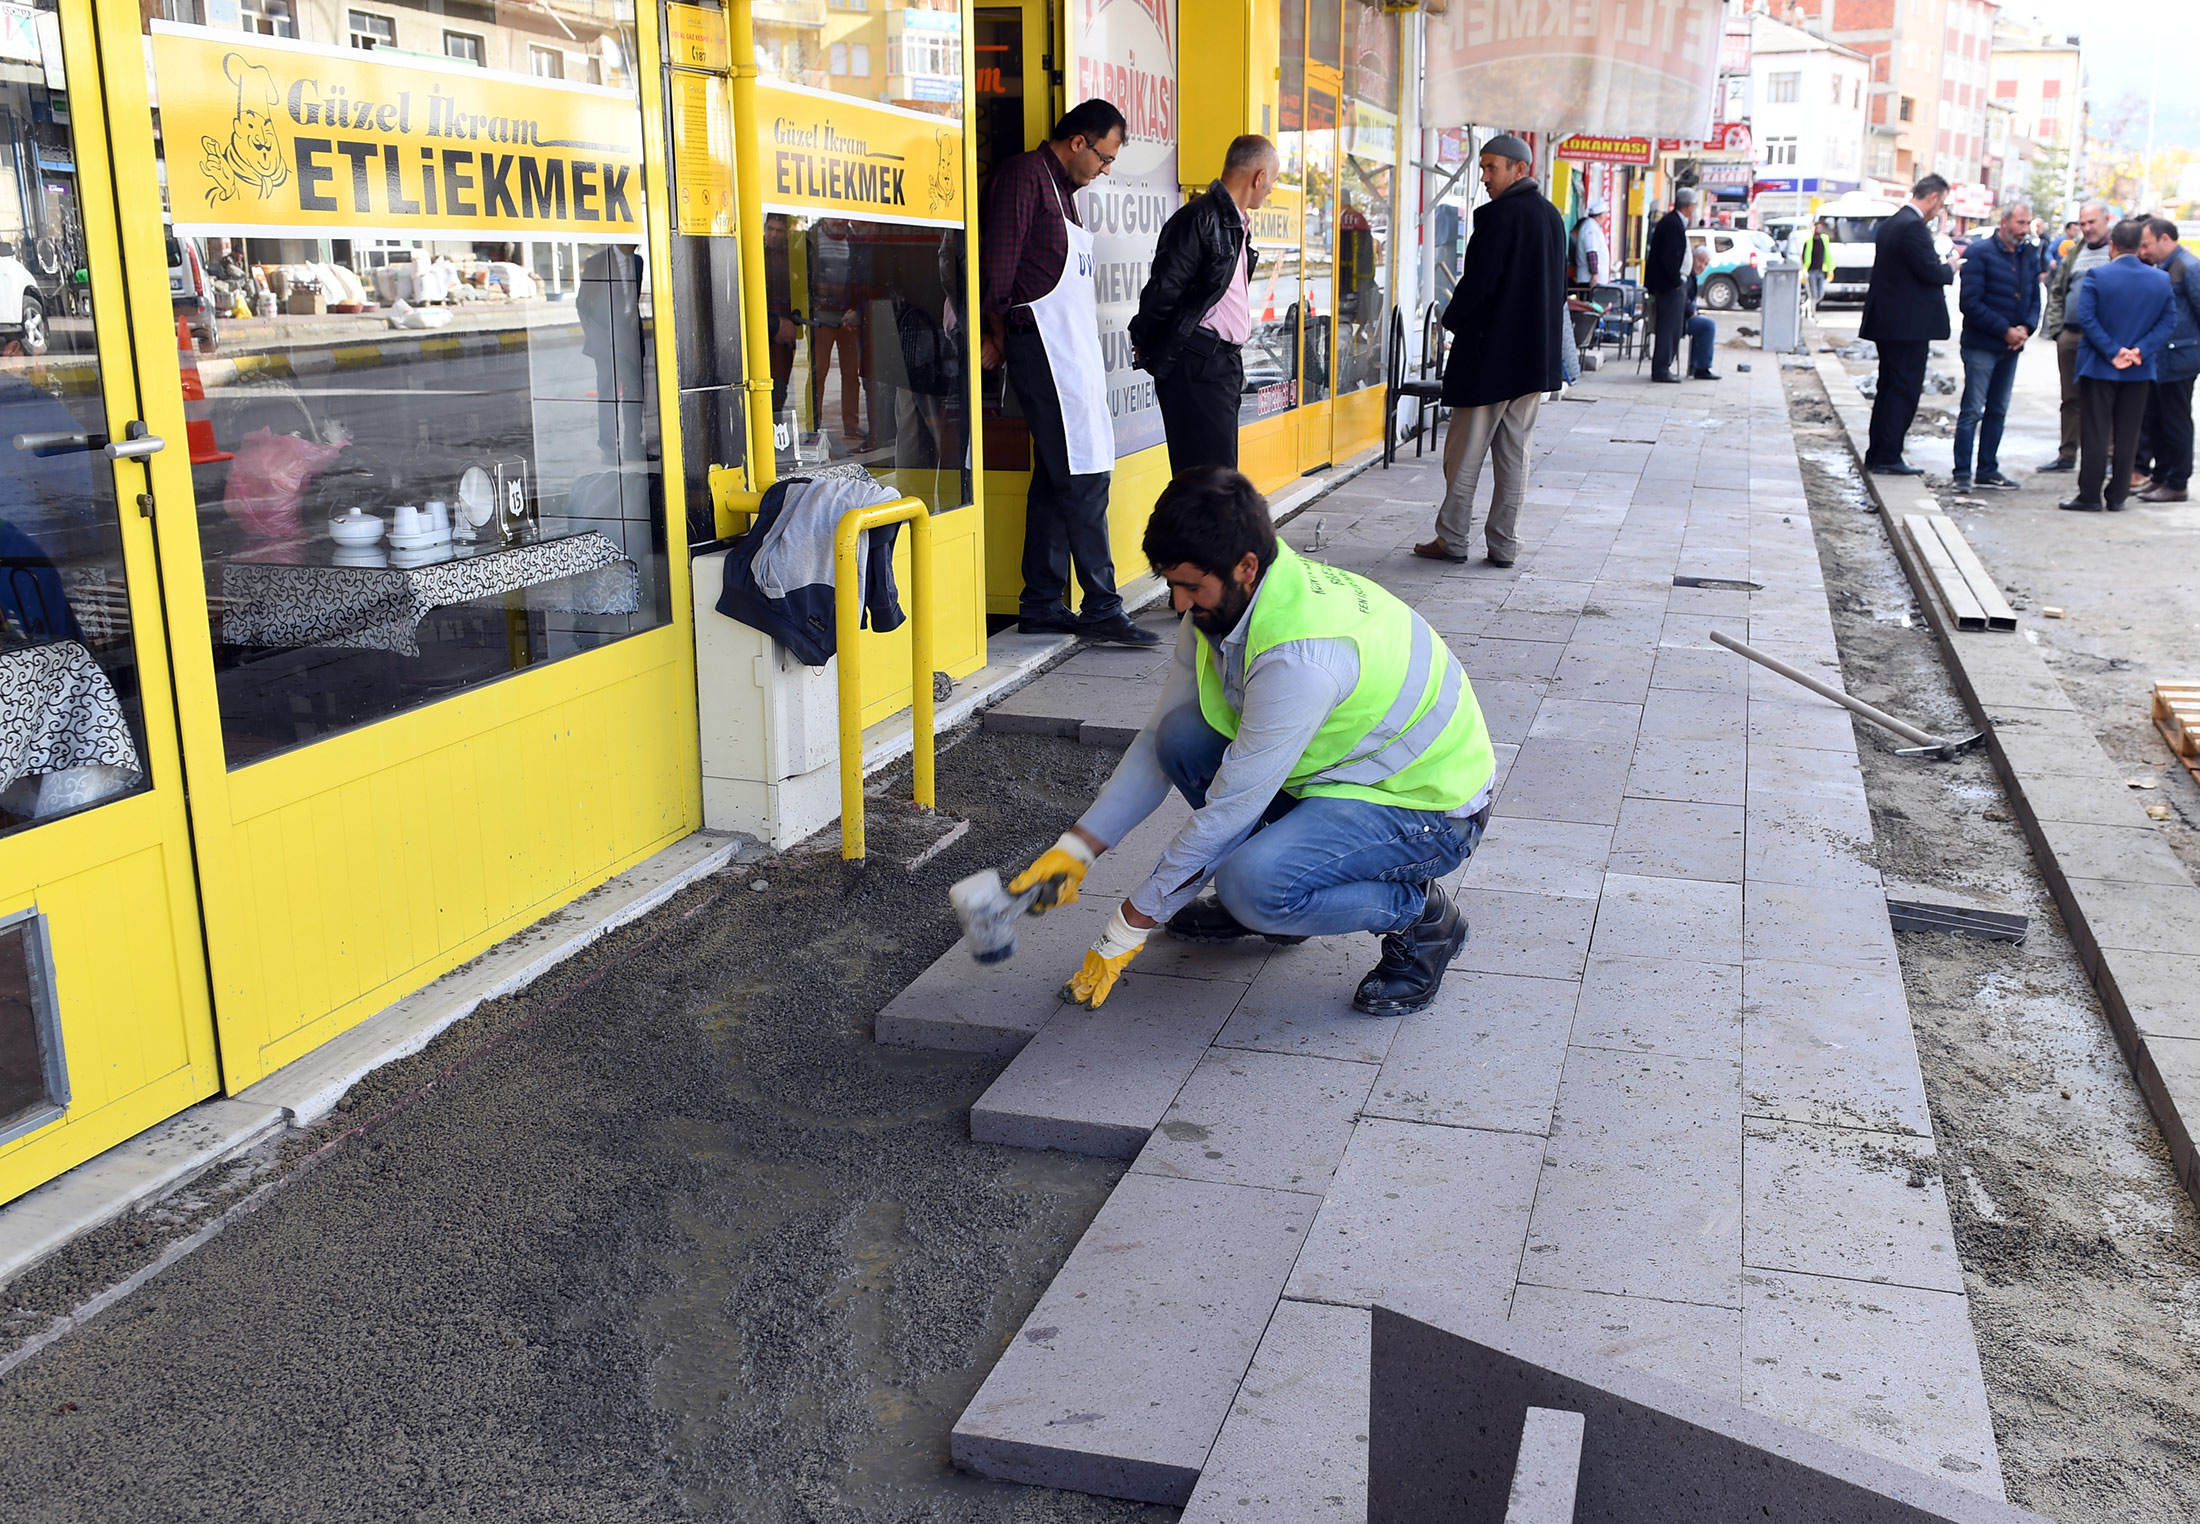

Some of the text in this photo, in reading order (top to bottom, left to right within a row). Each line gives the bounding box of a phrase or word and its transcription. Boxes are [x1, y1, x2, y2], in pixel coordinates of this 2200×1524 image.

[686, 33, 695, 41] GAZ
[695, 51, 707, 62] 187
[287, 78, 412, 135] Güzel
[425, 83, 631, 153] İkram
[774, 117, 818, 149] Güzel
[1562, 138, 1648, 154] LOKANTASI
[1088, 179, 1167, 235] DÜĞÜN
[777, 432, 786, 446] 11
[512, 491, 521, 510] 15
